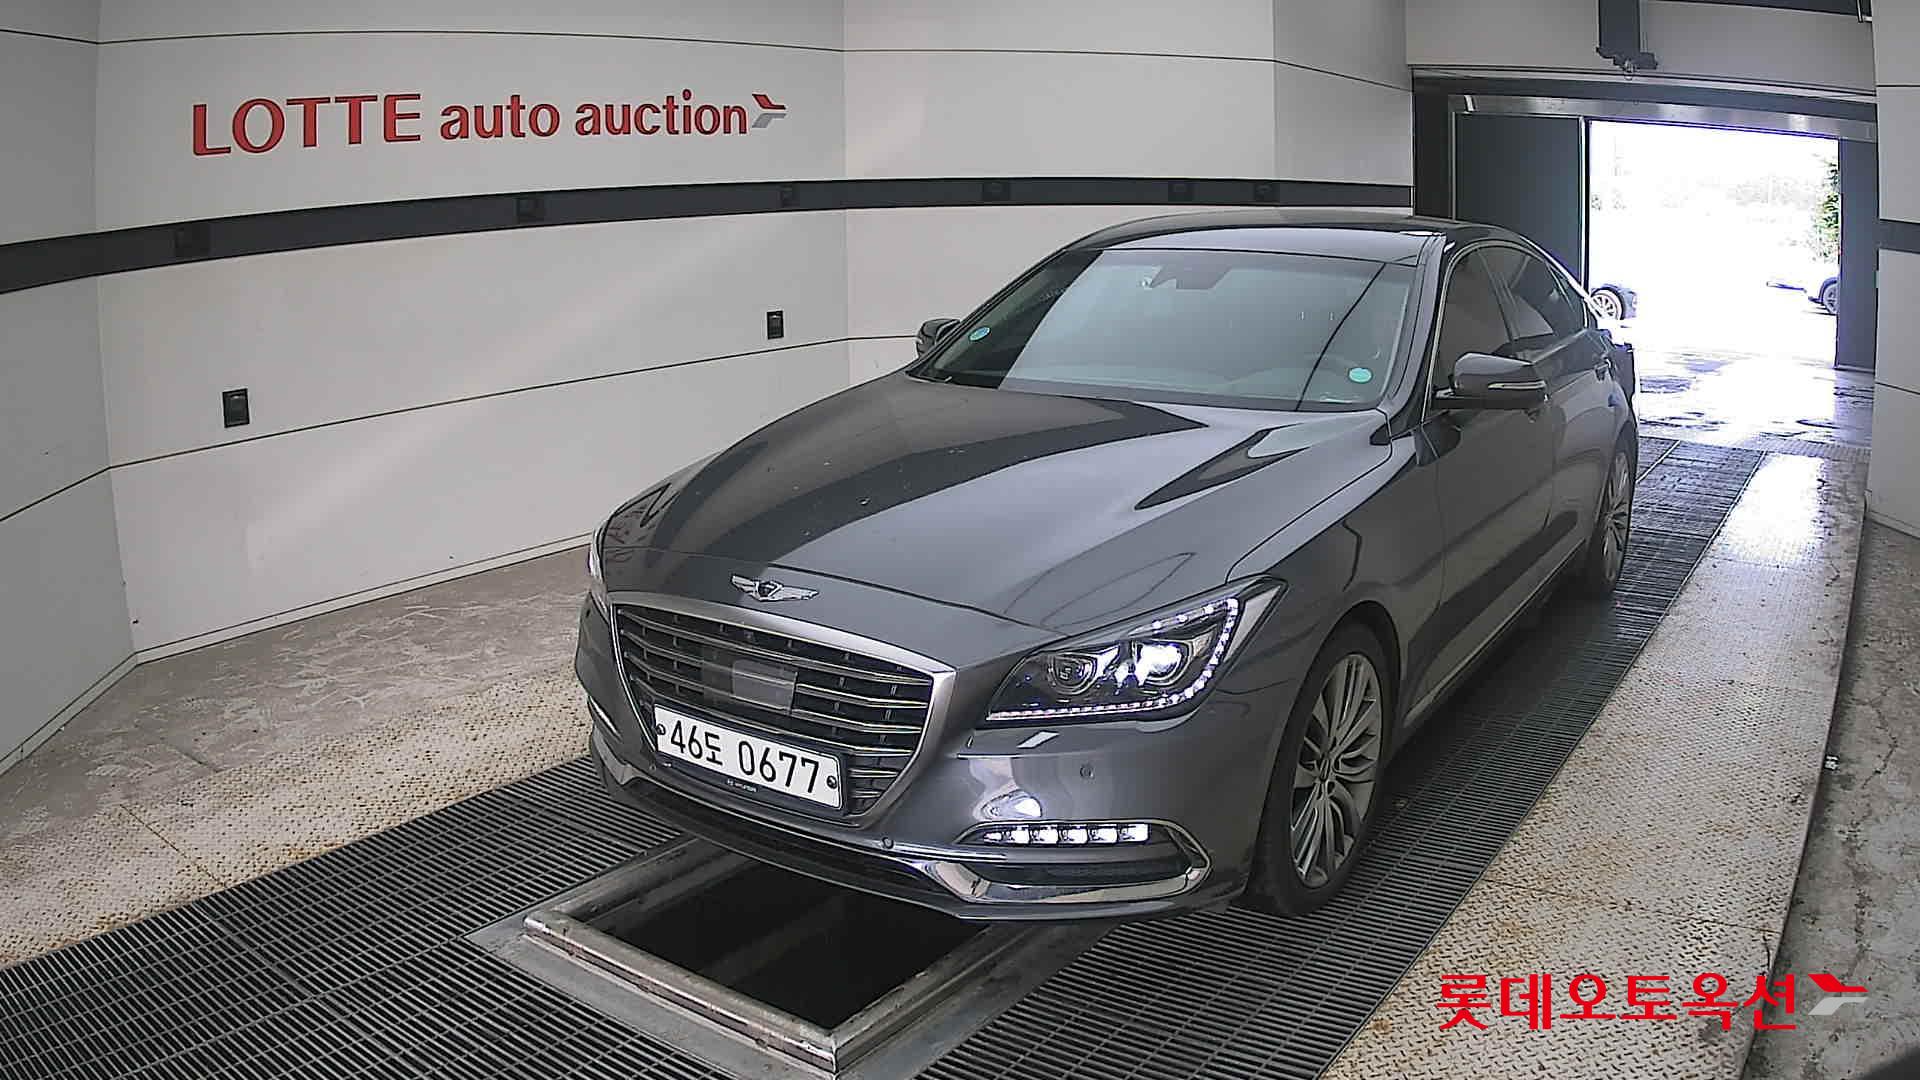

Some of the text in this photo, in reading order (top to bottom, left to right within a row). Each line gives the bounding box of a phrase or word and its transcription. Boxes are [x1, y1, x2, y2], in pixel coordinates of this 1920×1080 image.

[192, 89, 748, 156] LOTTE auto auction
[670, 719, 819, 794] 46도 0677
